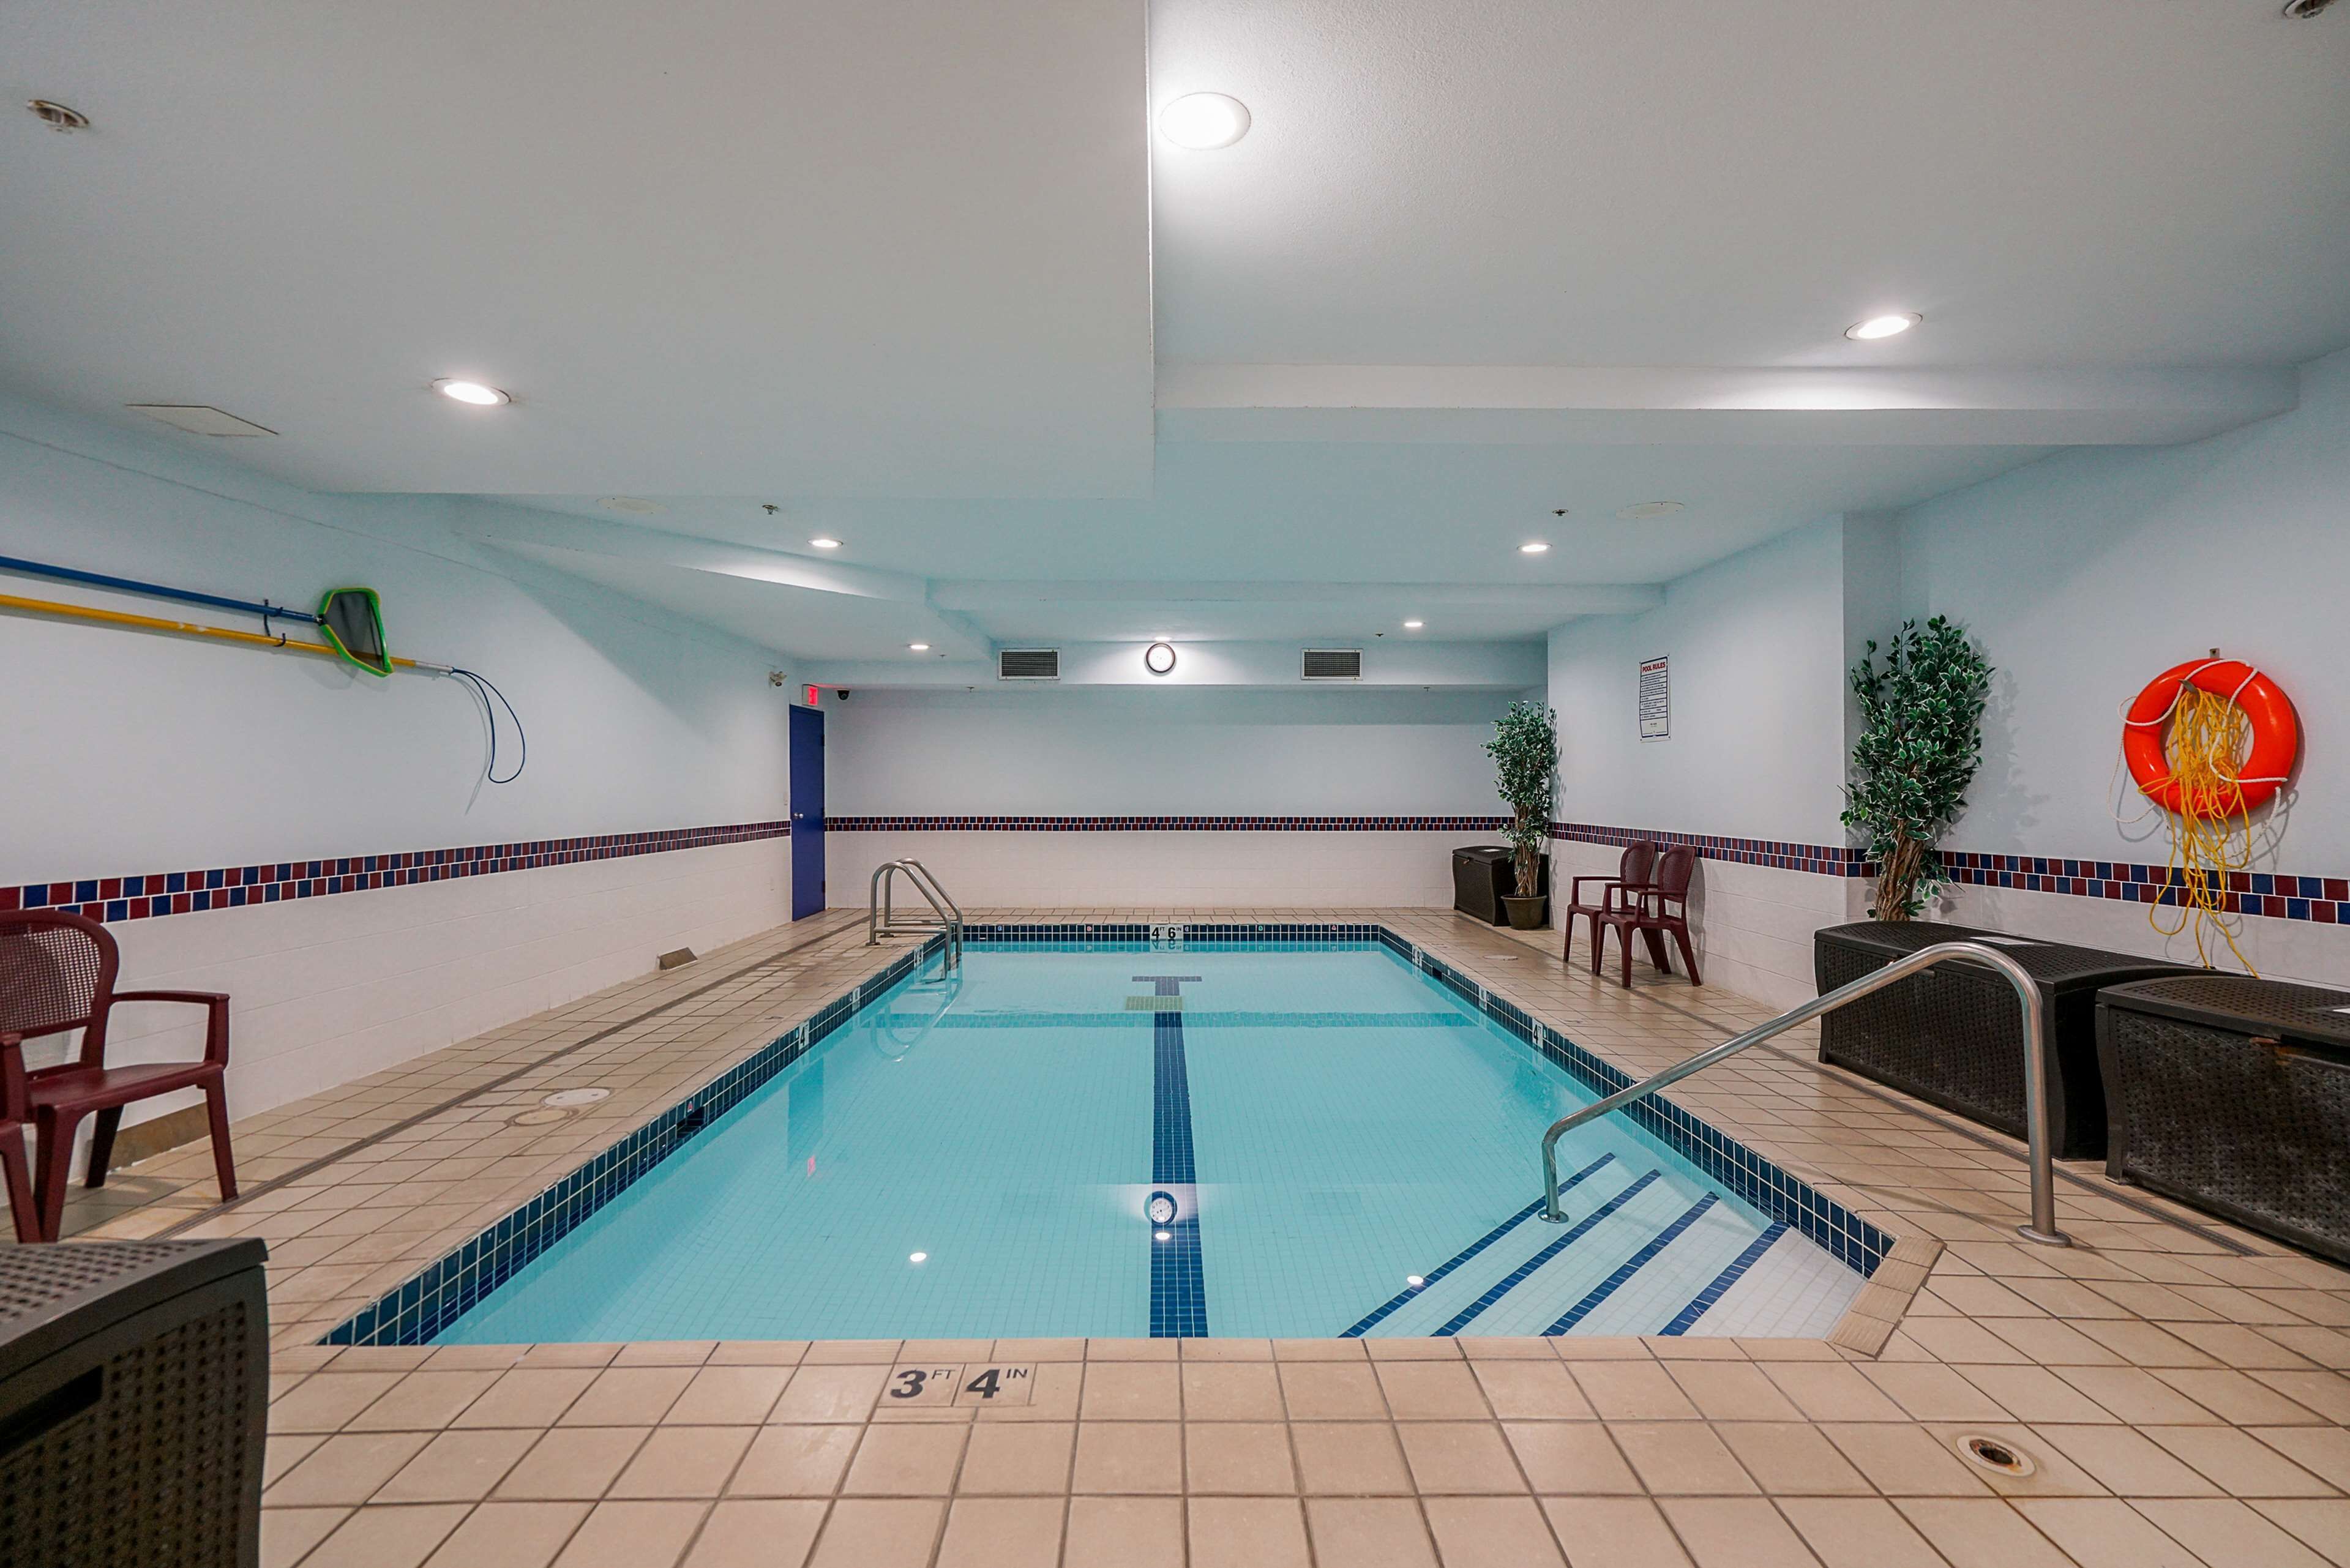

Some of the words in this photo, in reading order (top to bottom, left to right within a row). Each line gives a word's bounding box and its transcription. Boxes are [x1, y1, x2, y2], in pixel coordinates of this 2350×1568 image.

[1653, 662, 1666, 671] RULES
[1151, 927, 1160, 939] 4
[1168, 927, 1176, 939] 6
[1533, 1024, 1538, 1044] 4
[890, 1370, 927, 1398] 3
[931, 1368, 956, 1379] FT
[964, 1368, 1001, 1399] 4
[1006, 1368, 1028, 1379] IN
